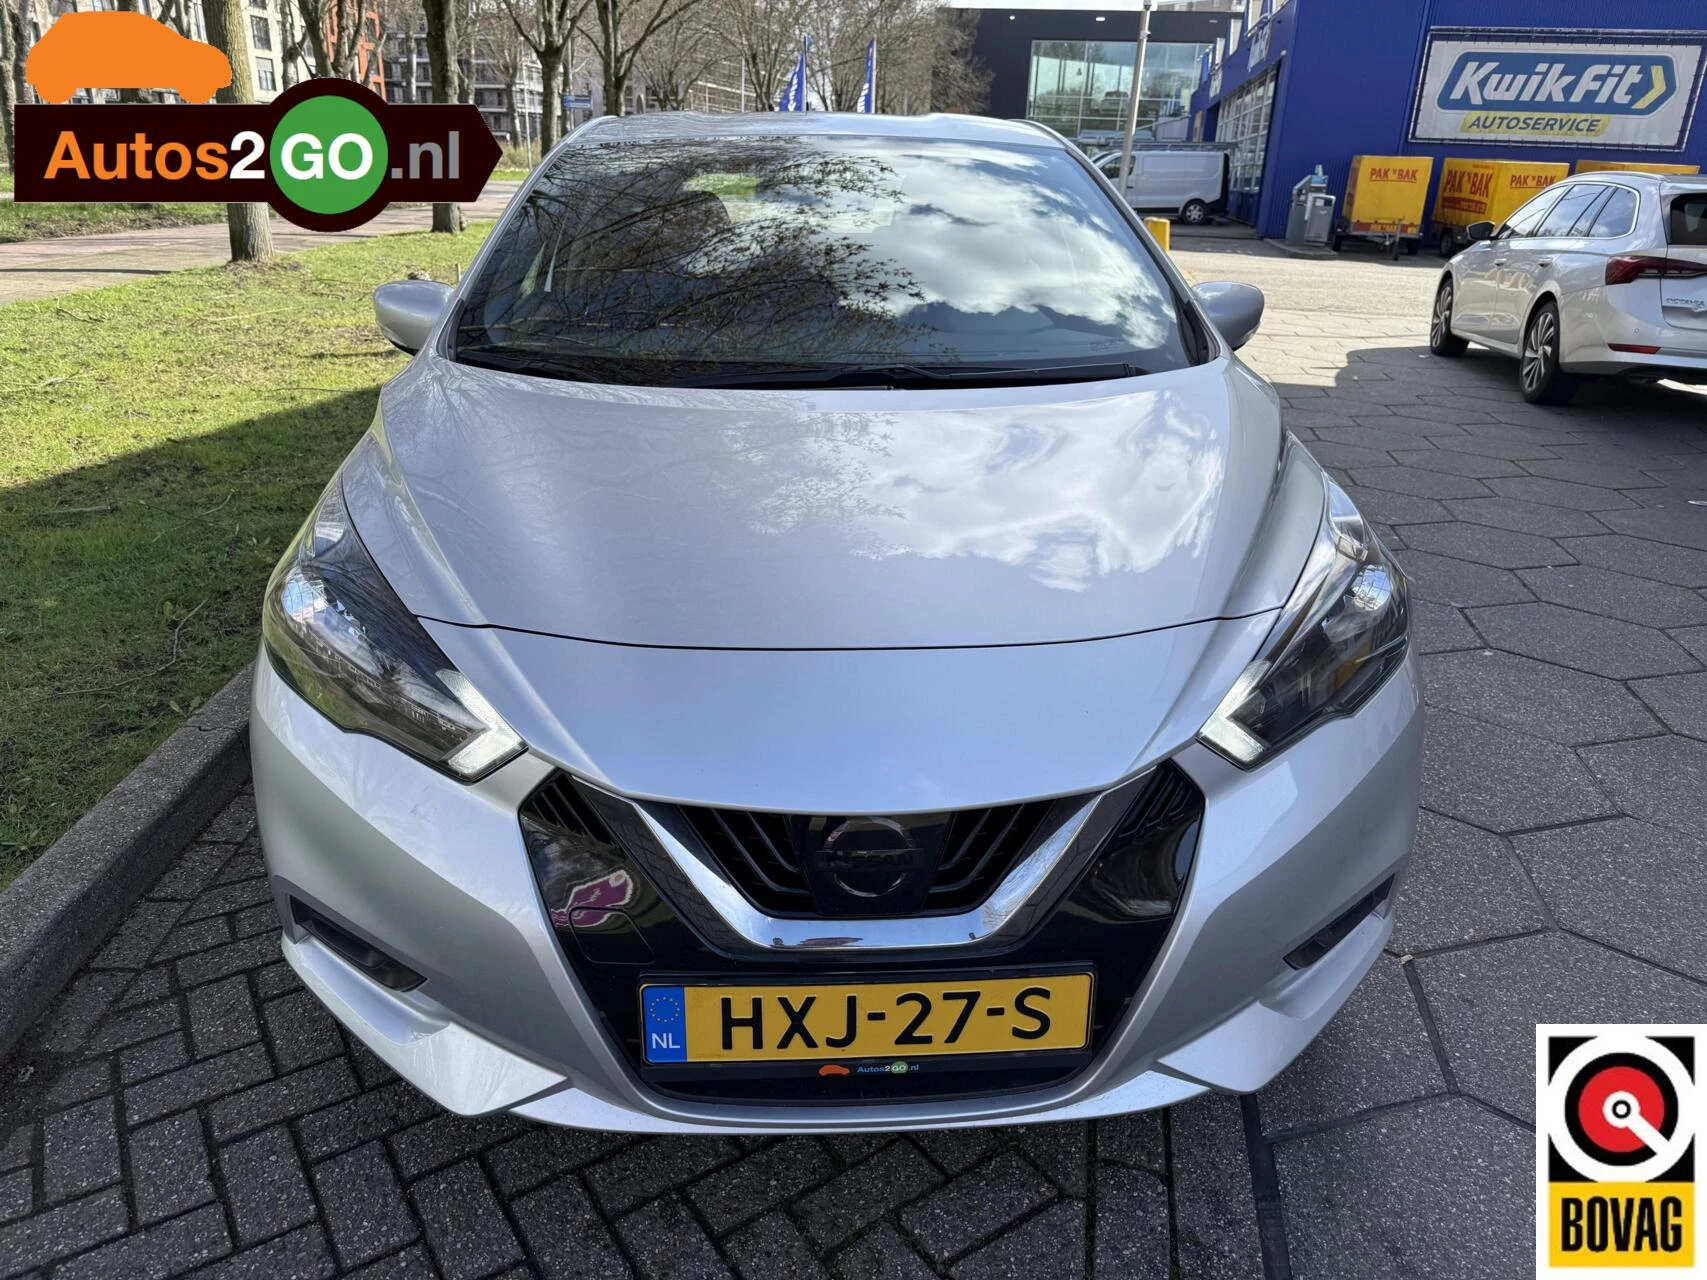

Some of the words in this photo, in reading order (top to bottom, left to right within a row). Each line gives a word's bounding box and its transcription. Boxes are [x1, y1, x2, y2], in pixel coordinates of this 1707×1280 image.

[1469, 115, 1601, 132] AUTOSERVICE
[1370, 167, 1390, 180] PAK
[1397, 168, 1418, 181] BAK
[1510, 175, 1529, 186] PAK
[1443, 169, 1466, 193] PAK
[1470, 172, 1494, 199] BAK
[720, 986, 1051, 1051] HXJ-27-S
[651, 1032, 681, 1049] NL
